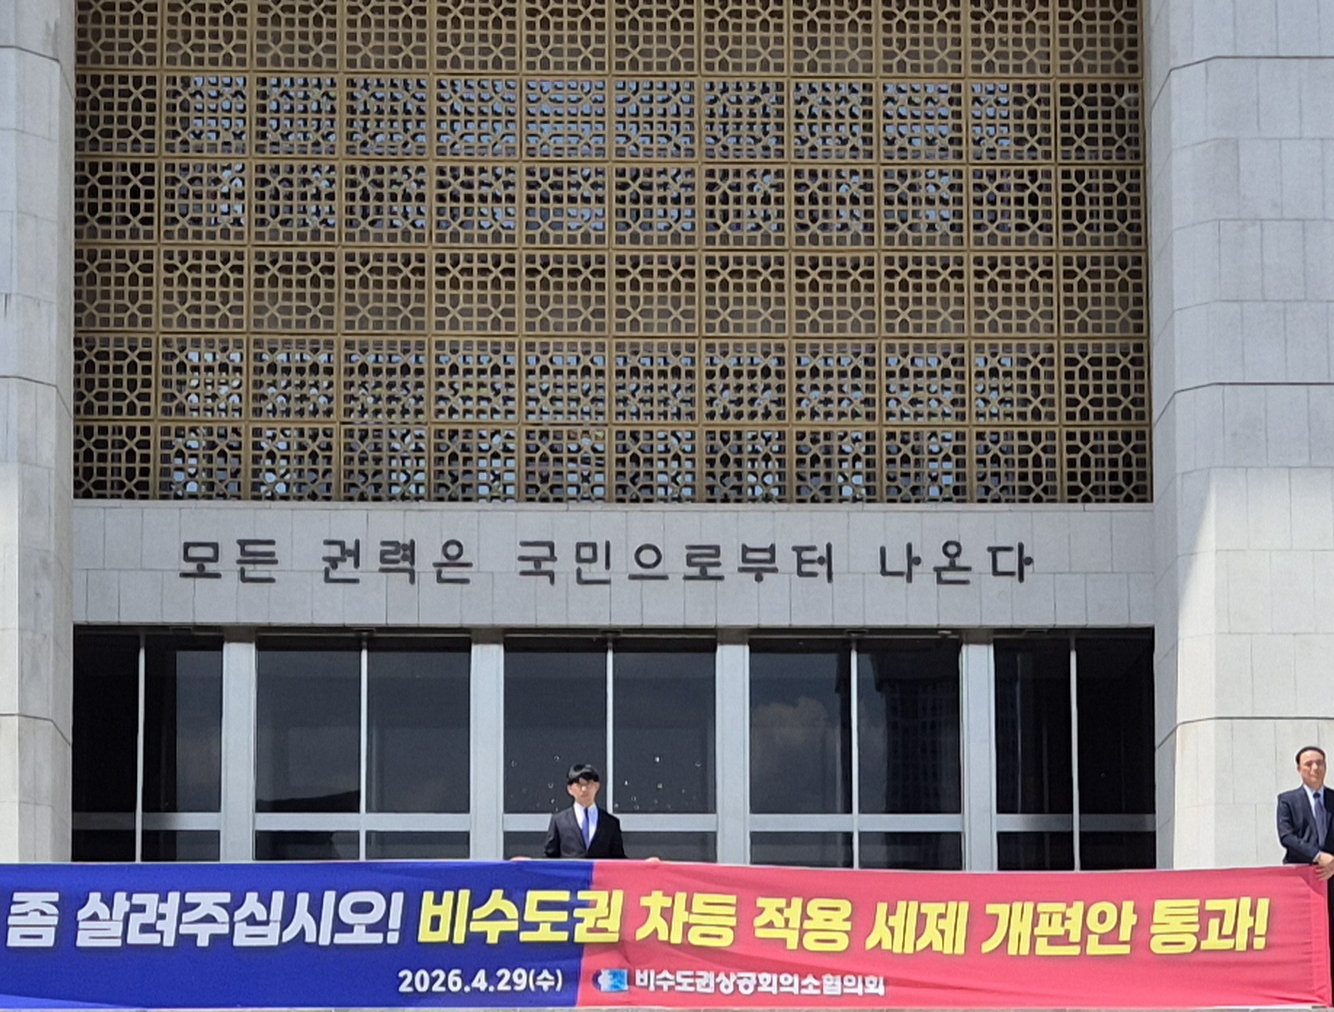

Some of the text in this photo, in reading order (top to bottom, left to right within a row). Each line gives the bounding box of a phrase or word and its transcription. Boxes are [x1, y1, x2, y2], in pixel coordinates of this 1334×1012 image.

[180, 539, 1034, 585] 모든 권력은 국민으로부터 나온다
[7, 893, 59, 946] 좀
[77, 891, 403, 946] 살려주십시오!
[420, 891, 624, 944] 비수도권
[636, 891, 737, 948] 차등
[754, 898, 852, 952] 적용
[866, 902, 969, 955] 세제
[982, 902, 1137, 956] 개편안
[1150, 898, 1270, 954] 통과!
[399, 968, 562, 992] 2026.4.29(수)
[636, 970, 885, 996] 비수도권상공회의소협의회
